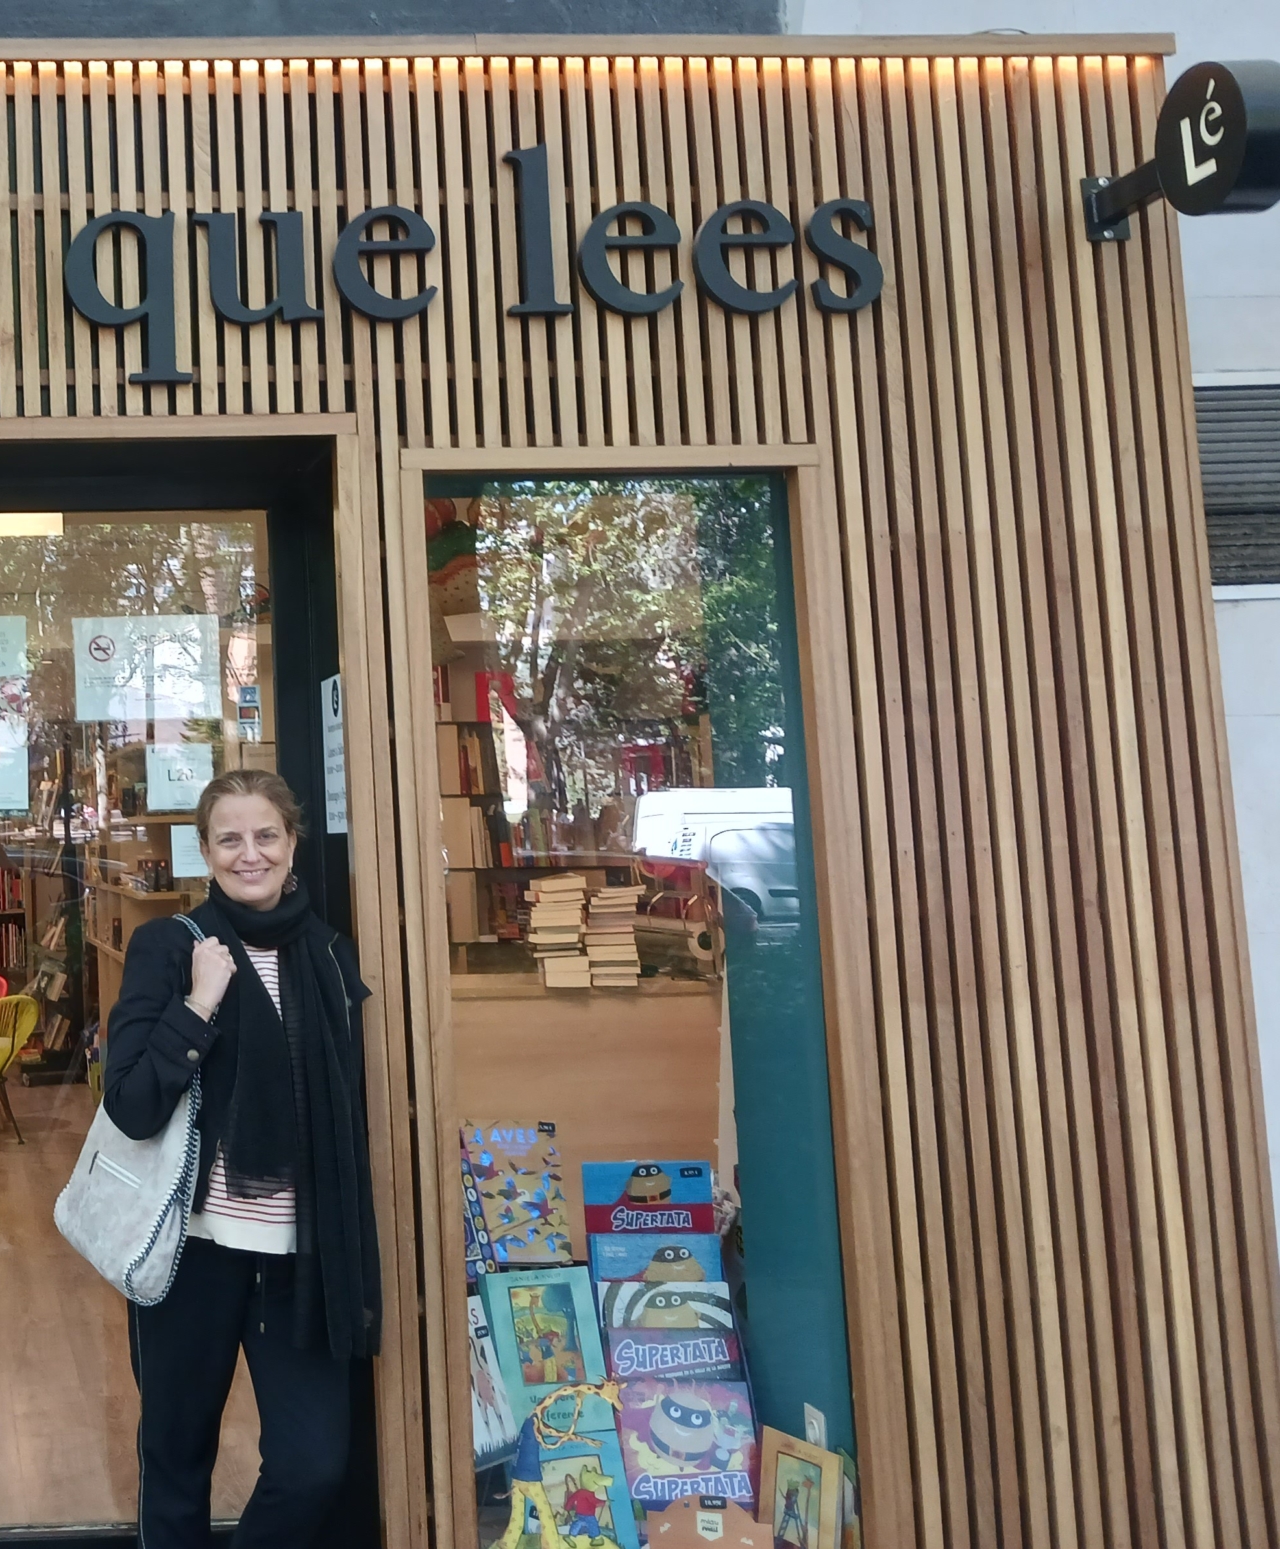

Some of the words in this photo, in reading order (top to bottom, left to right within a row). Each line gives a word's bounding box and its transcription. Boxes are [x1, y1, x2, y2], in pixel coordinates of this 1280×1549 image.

[1179, 78, 1224, 186] Lé
[65, 205, 438, 384] que
[502, 143, 884, 317] lees
[490, 1128, 538, 1144] AVES
[611, 1206, 692, 1231] SUPERTATA
[614, 1337, 730, 1376] SUPERTATA
[632, 1471, 753, 1501] SUPERTATA
